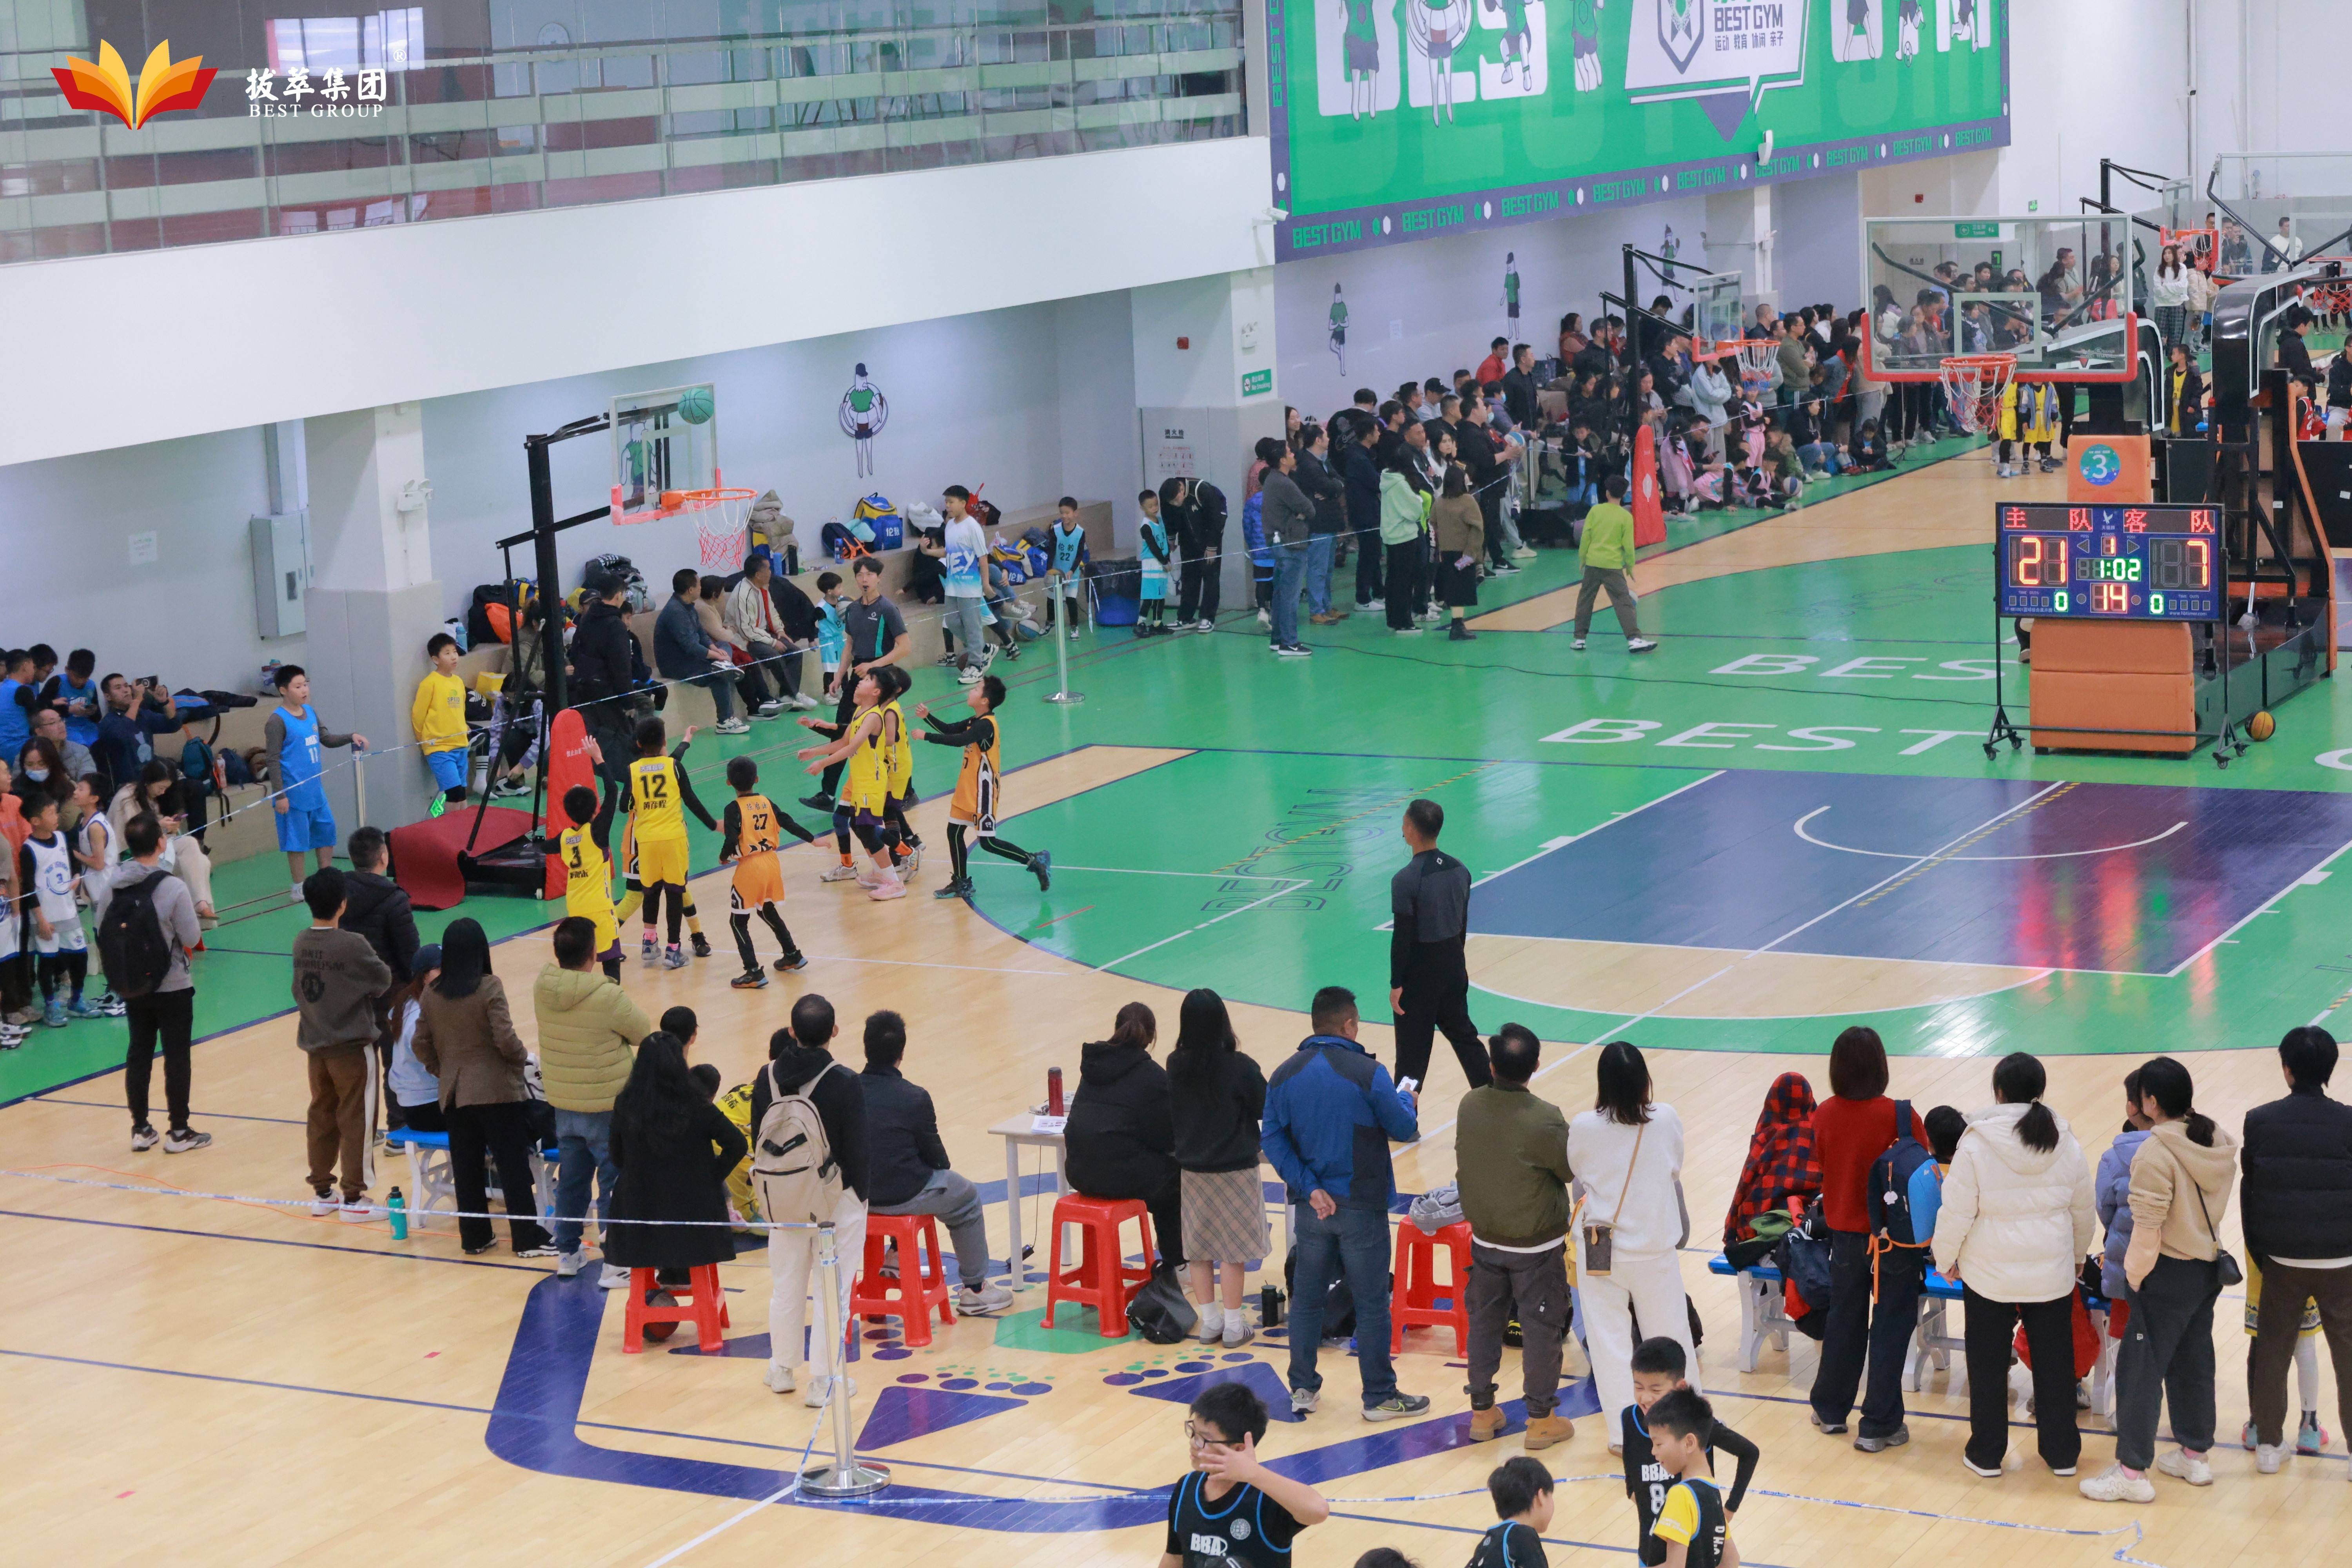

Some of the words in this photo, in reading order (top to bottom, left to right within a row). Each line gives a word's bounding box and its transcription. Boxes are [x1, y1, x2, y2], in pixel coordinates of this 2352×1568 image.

[1714, 5, 1750, 32] BEST
[1753, 4, 1783, 29] GYM
[1715, 35, 1729, 51] 运动
[1734, 34, 1747, 50] 教育
[1752, 33, 1765, 48] 休闲
[1770, 31, 1783, 46] 亲子
[1893, 140, 1913, 156] BEST
[1915, 136, 1932, 152] GYM
[1955, 131, 1975, 146] BEST
[1976, 127, 1991, 143] GYM
[1755, 158, 1779, 178] BEST
[1780, 155, 1799, 171] GYM
[1826, 150, 1848, 167] BEST
[1850, 146, 1868, 162] GYM
[1677, 171, 1702, 189] BEST
[1704, 168, 1725, 185] GYM
[1593, 182, 1621, 203] BEST
[1622, 179, 1645, 197] GYM
[1501, 194, 1532, 216] BEST
[1534, 191, 1558, 211] GYM
[1403, 209, 1435, 231] BEST
[1437, 205, 1464, 226] GYM
[1293, 224, 1328, 249] BEST
[1333, 220, 1361, 241] GYM
[2092, 454, 2107, 479] 3
[1060, 552, 1070, 561] 22
[2019, 537, 2065, 585] 21
[2187, 540, 2207, 586] 7
[2100, 558, 2140, 581] 1:02
[2055, 592, 2068, 611] 0
[2103, 584, 2126, 612] 14
[2150, 594, 2163, 613] 0
[1708, 654, 2022, 680] BES
[1538, 719, 1991, 755] BEST
[640, 773, 667, 799] 12
[753, 813, 768, 831] 27
[570, 846, 582, 869] 3
